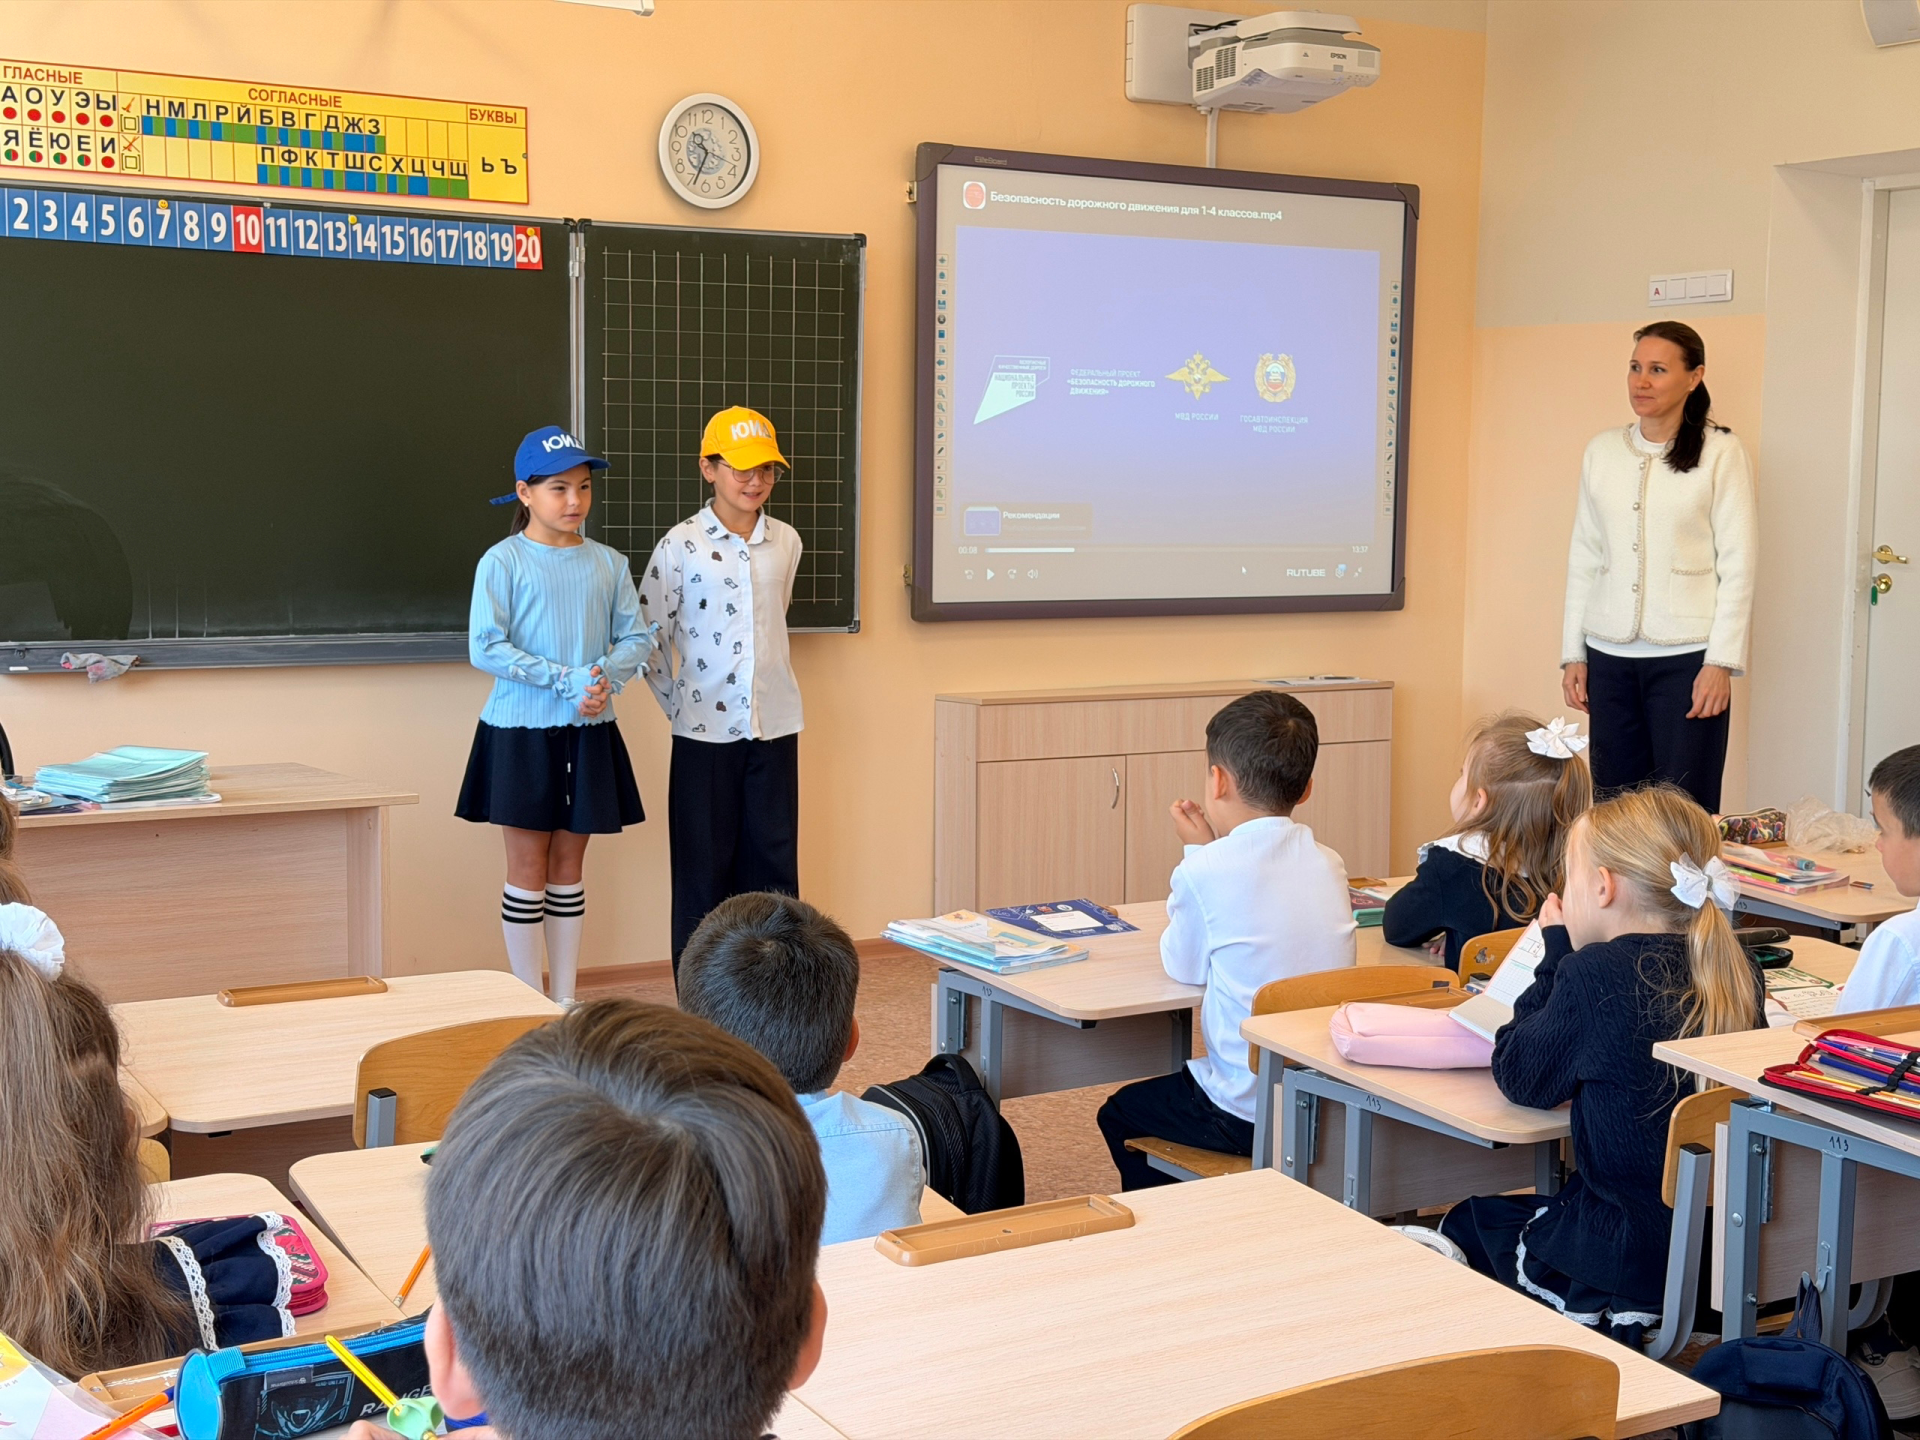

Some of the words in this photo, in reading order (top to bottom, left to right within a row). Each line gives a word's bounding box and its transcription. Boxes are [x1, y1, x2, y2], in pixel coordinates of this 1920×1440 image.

[1330, 52, 1347, 60] EPSON
[3, 66, 83, 84] ГЛАСНЫЕ
[248, 88, 342, 108] СОГЛАСНЫЕ
[469, 108, 518, 124] БУКВЫ
[687, 112, 697, 127] 11
[701, 109, 714, 125] 12
[720, 116, 725, 130] 1
[674, 123, 688, 138] 10
[728, 130, 738, 144] 2
[671, 141, 682, 155] 9
[731, 147, 741, 162] 3
[675, 158, 685, 174] 8
[727, 164, 737, 178] 4
[687, 172, 696, 186] 7
[701, 179, 711, 193] 6
[716, 176, 726, 189] 5
[990, 191, 1066, 206] Безопасность
[1067, 198, 1126, 210] дорожного
[1128, 202, 1179, 214] движения
[1181, 206, 1199, 216] для
[1201, 206, 1216, 216] 1-4
[1218, 210, 1282, 222] классов.mp4
[13, 197, 29, 230] 2
[42, 199, 58, 232] 3
[71, 202, 89, 234] 4
[101, 204, 115, 236] 5
[128, 206, 144, 238] 6
[156, 208, 171, 239] 7
[184, 211, 200, 241] 8
[211, 212, 226, 243] 9
[236, 214, 260, 245] 10
[266, 216, 287, 248] 11
[294, 219, 319, 250] 12
[323, 221, 347, 252] 13
[353, 224, 377, 253] 14
[381, 225, 405, 255] 15
[410, 227, 433, 257] 16
[437, 229, 459, 258] 17
[464, 231, 487, 260] 18
[491, 232, 514, 261] 19
[516, 233, 540, 263] 20
[1175, 412, 1190, 421] МВД
[1191, 413, 1219, 421] РОССИИ
[1003, 511, 1060, 520] Рекомендации
[1286, 568, 1326, 577] RUTUBE
[1366, 1095, 1382, 1112] 113
[1829, 1136, 1849, 1152] 113
